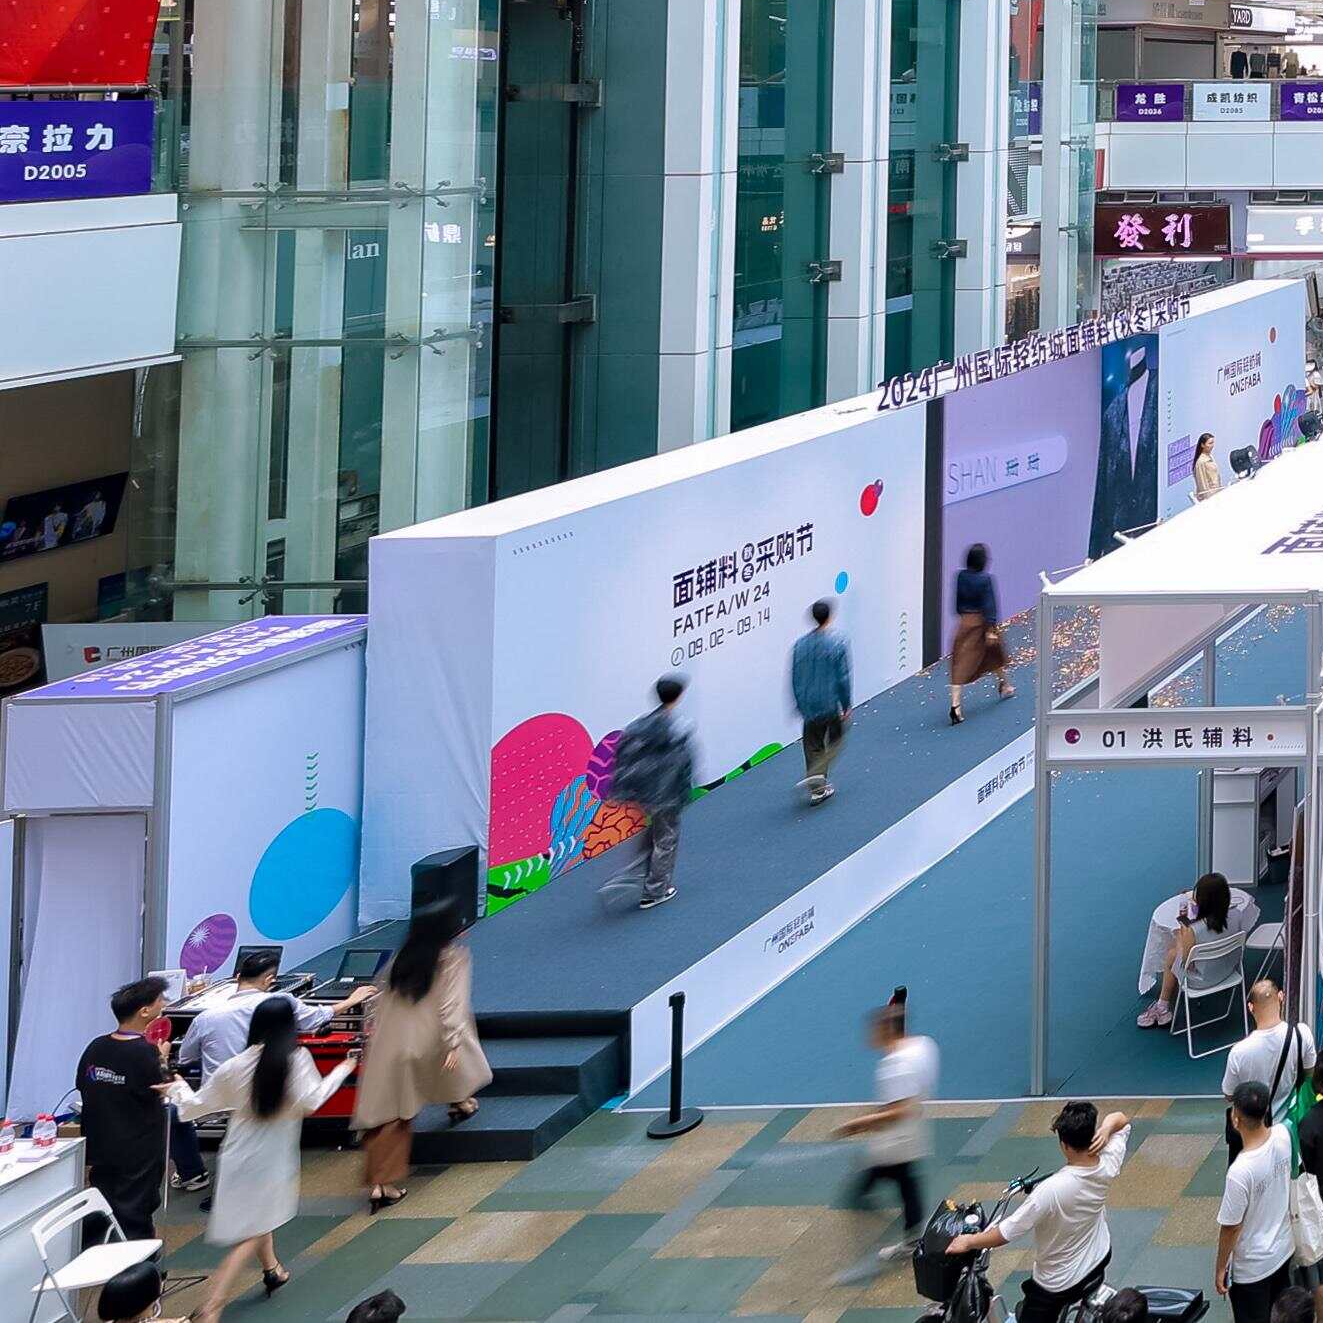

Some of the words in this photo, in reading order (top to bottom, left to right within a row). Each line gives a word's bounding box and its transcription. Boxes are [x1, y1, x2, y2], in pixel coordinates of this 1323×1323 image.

[1138, 107, 1162, 115] D2036
[1206, 92, 1258, 104] 成凯纺织
[0, 124, 115, 154] 奈拉力
[23, 163, 87, 182] D2005
[1113, 212, 1193, 251] 發利
[1216, 349, 1262, 388] 广州国际轻纺城
[1229, 373, 1262, 397] ONEFABA
[947, 453, 998, 497] SHAN
[673, 600, 717, 637] FATF
[717, 589, 750, 620] A/W
[754, 581, 771, 600] 24
[688, 629, 724, 660] 09.02
[737, 606, 772, 639] 09.14
[1102, 727, 1129, 747] 01
[1142, 724, 1256, 749] 洪氏辅料
